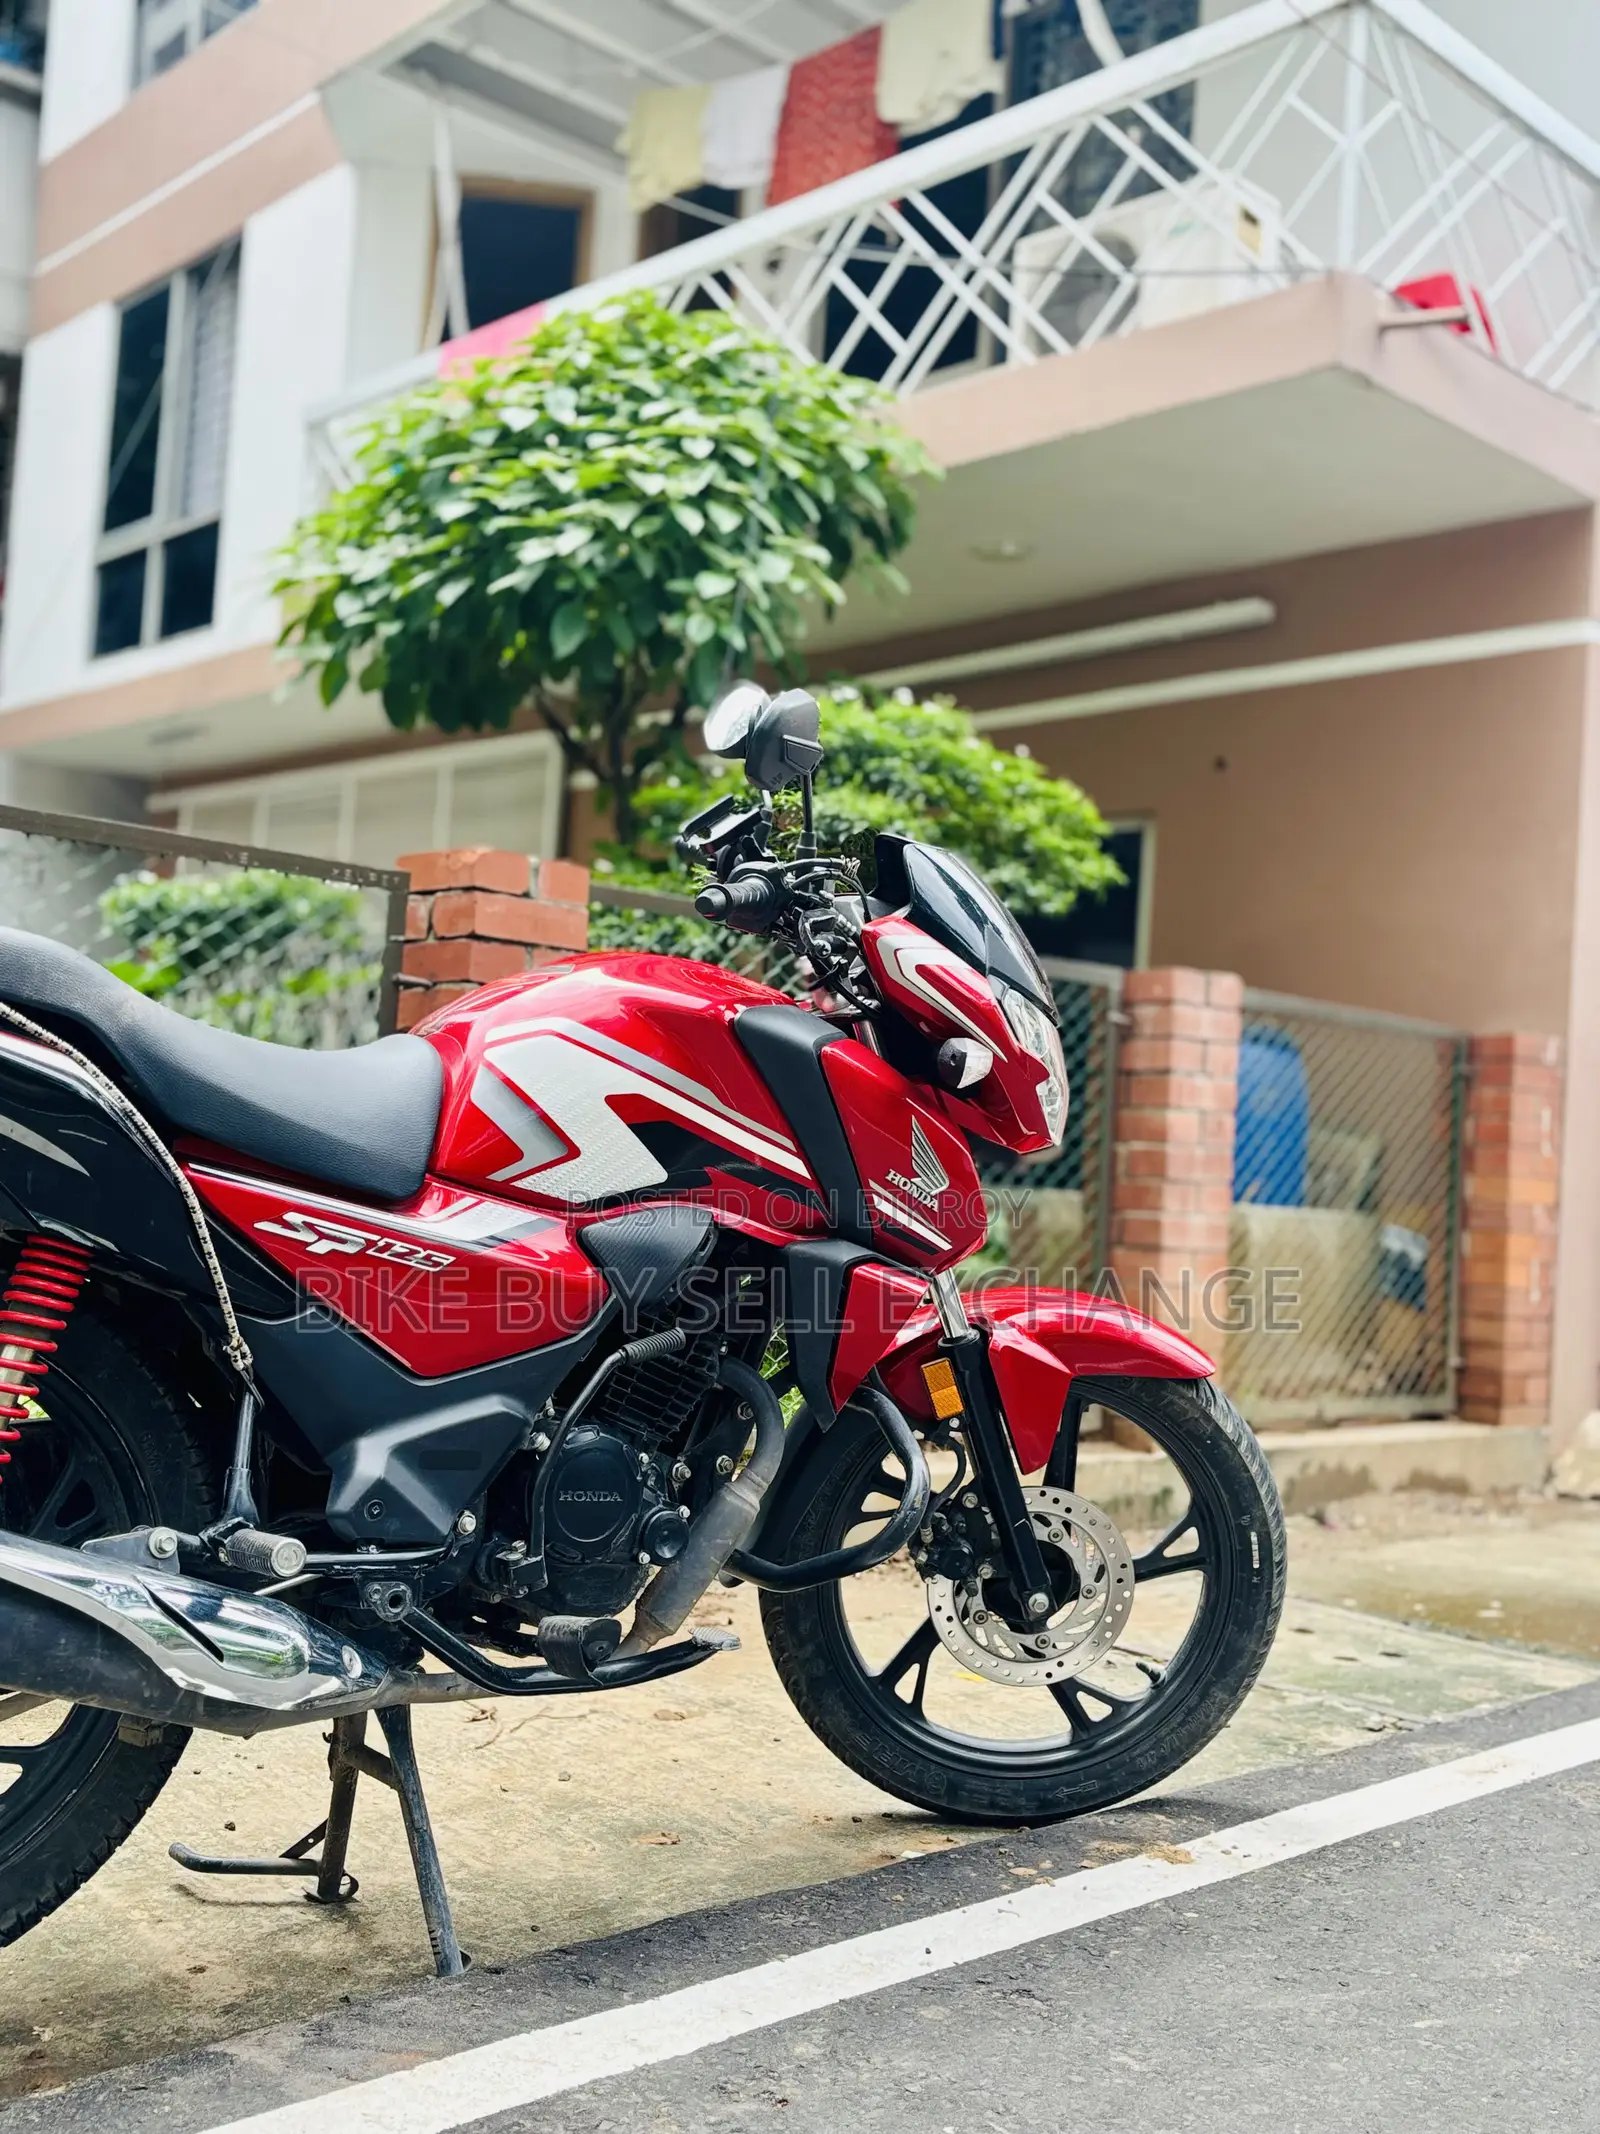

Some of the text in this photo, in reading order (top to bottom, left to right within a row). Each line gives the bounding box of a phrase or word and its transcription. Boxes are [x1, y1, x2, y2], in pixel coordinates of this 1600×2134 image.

[884, 1168, 939, 1213] HONDA
[253, 1211, 457, 1272] SP 125
[558, 1490, 624, 1502] HONDA
